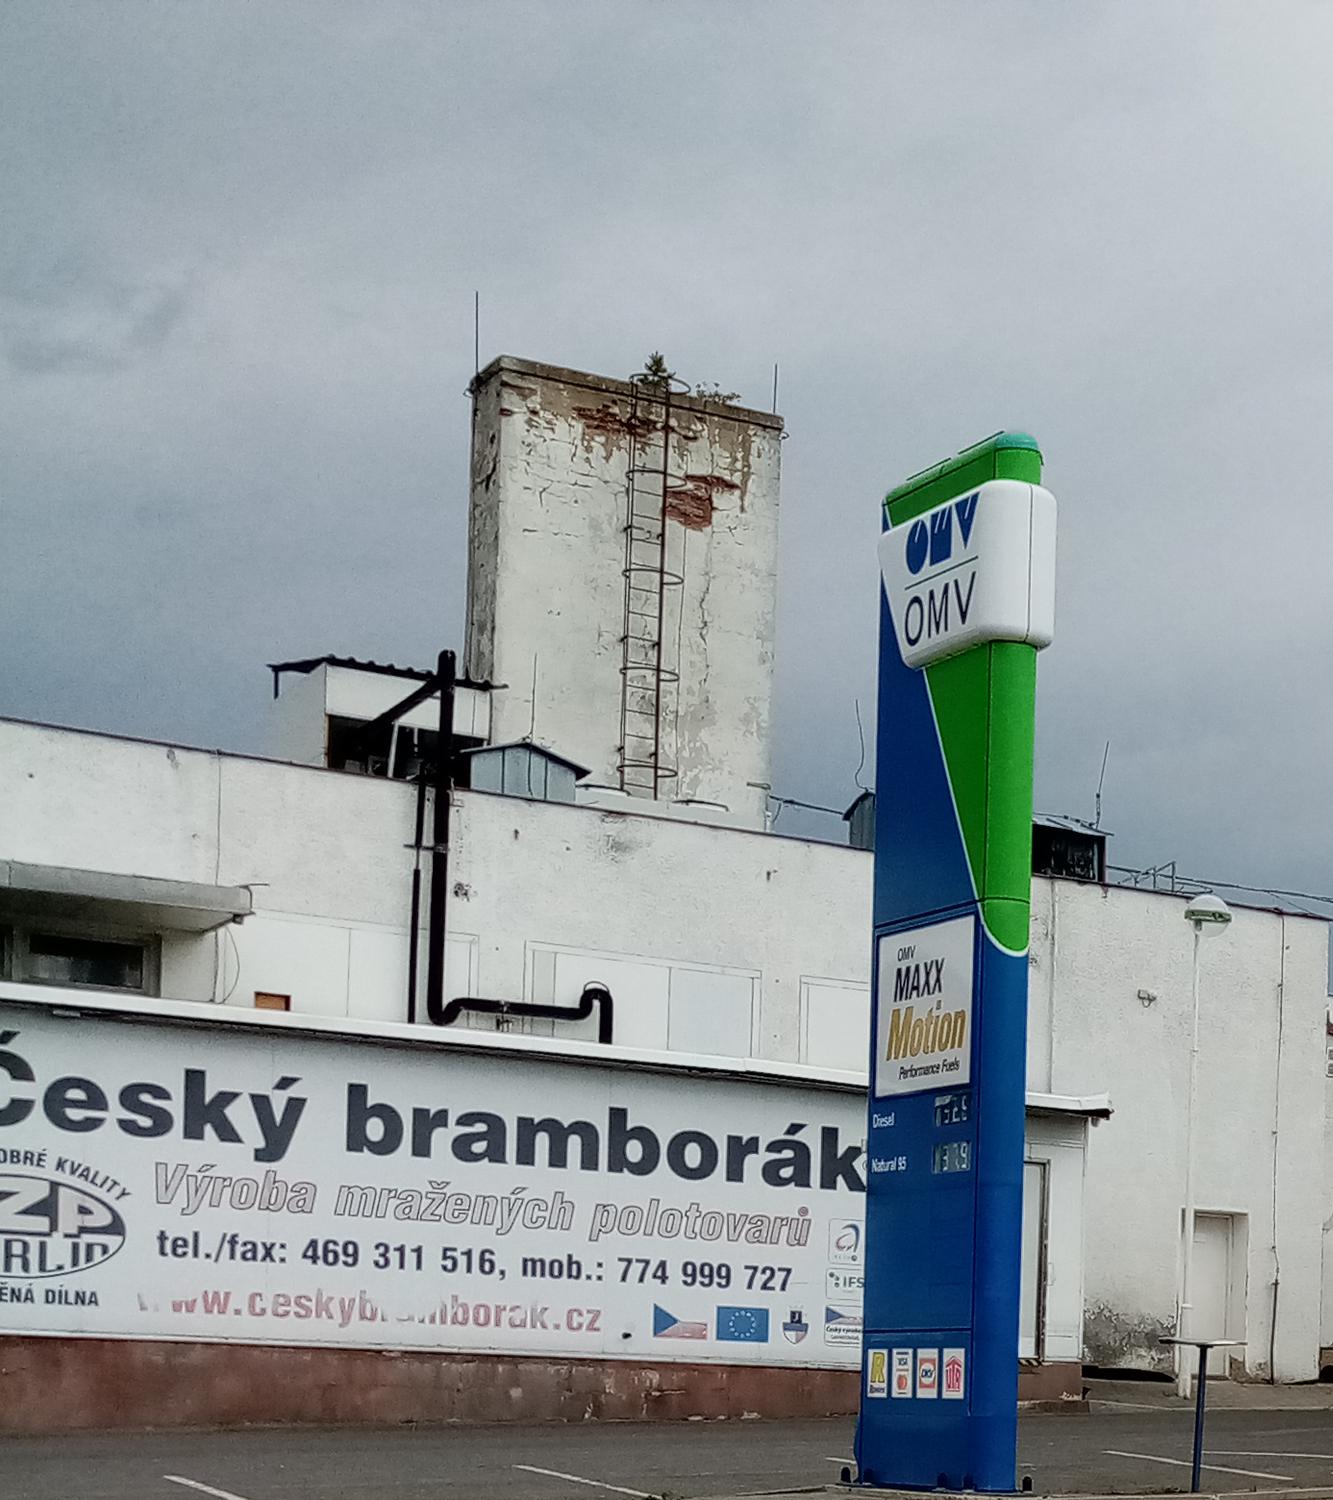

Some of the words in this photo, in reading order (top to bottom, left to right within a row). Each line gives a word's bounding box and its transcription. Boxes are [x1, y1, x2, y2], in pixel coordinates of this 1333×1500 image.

[905, 571, 976, 647] OMV
[898, 945, 916, 962] OMV
[894, 958, 945, 1003] MAXX
[886, 1001, 966, 1061] Motion
[899, 1063, 940, 1080] Performance
[941, 1057, 960, 1073] Fuels
[345, 1082, 867, 1193] bramborák
[872, 1112, 895, 1128] Diesel
[55, 1156, 132, 1201] KVALITY
[871, 1157, 897, 1173] Natural
[897, 1156, 907, 1171] 95
[155, 1162, 317, 1216] Výroba
[334, 1180, 575, 1236] mražených
[588, 1198, 811, 1247] polotovarů
[156, 1230, 288, 1264] tel./fax:
[301, 1237, 360, 1268] 469
[373, 1241, 424, 1271] 311
[440, 1246, 506, 1281] 516,
[521, 1253, 605, 1283] mob.:
[617, 1257, 669, 1286] 774
[681, 1261, 732, 1289] 999
[744, 1264, 793, 1292] 727
[843, 1276, 866, 1289] IFS
[45, 1285, 99, 1307] DÍLNA
